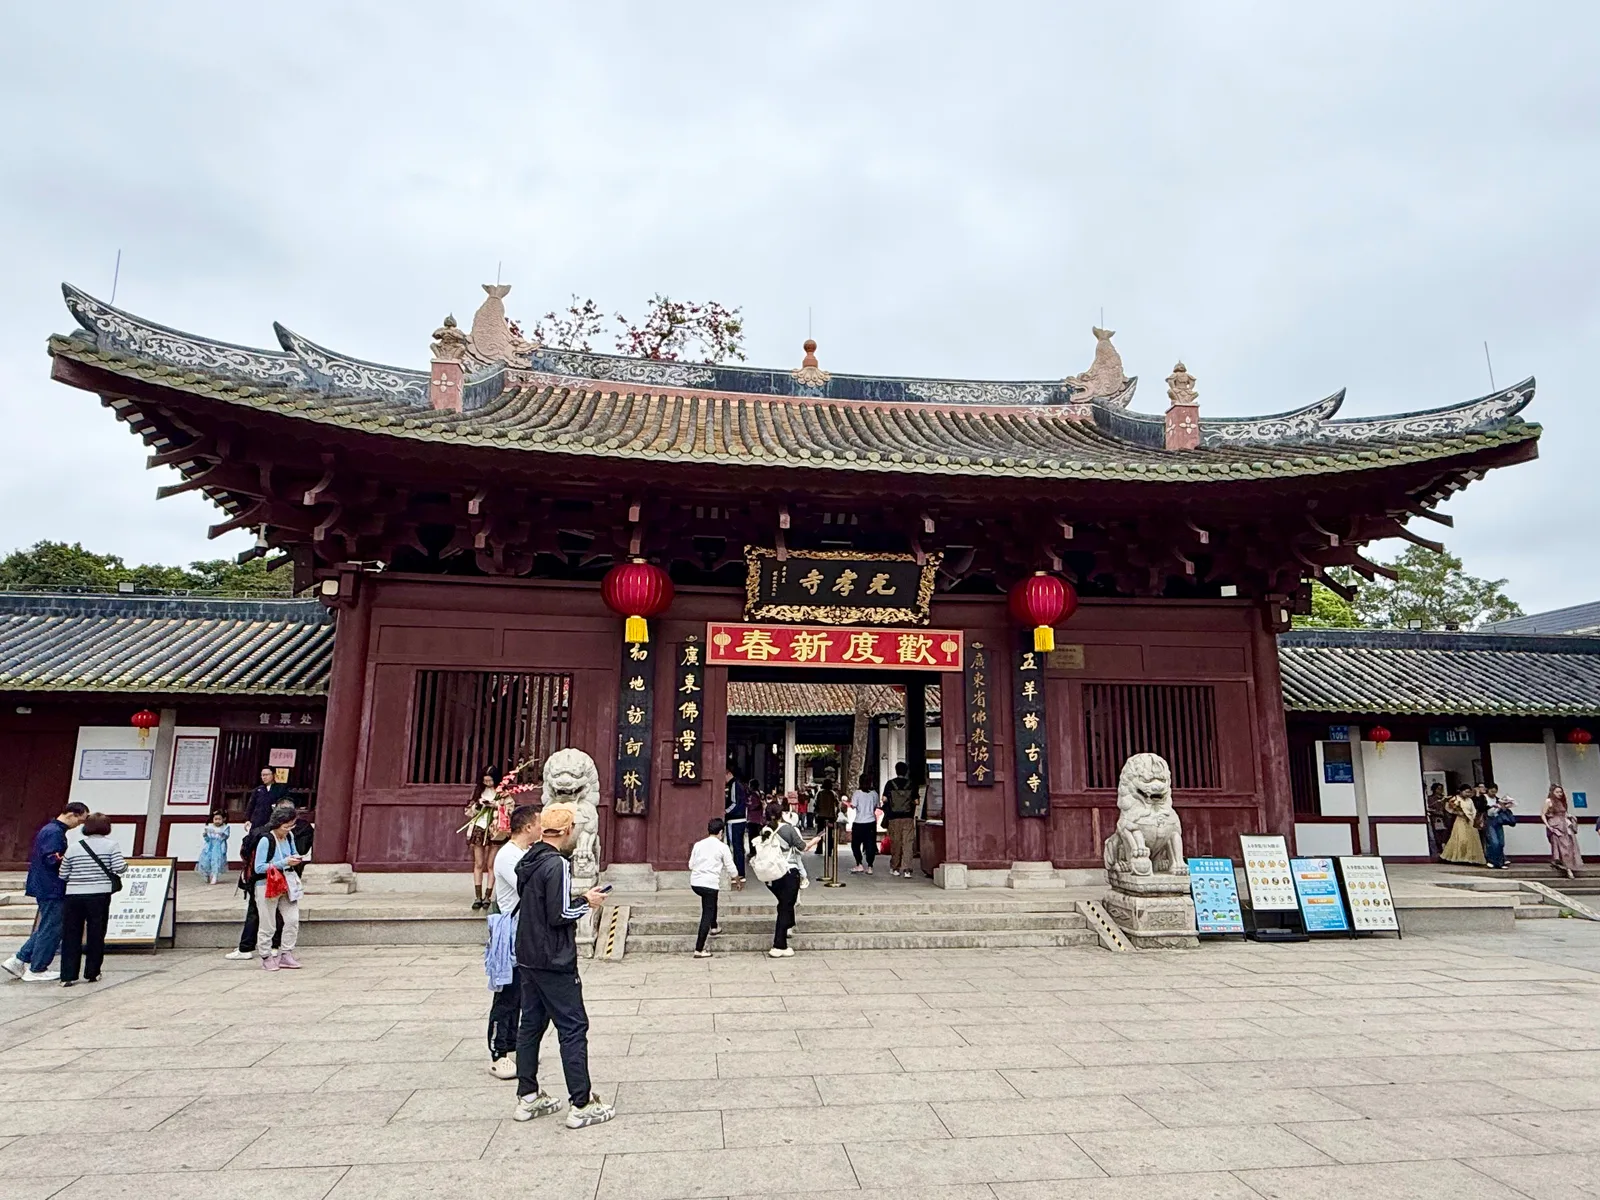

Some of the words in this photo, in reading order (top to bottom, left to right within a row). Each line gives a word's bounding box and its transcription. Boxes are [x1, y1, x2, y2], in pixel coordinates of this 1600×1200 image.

[799, 568, 897, 597] 光孝寺
[735, 628, 937, 665] 歡度新春
[259, 712, 312, 725] 售票处
[678, 646, 701, 779] 廣東佛學院
[970, 652, 991, 782] 廣東省佛教協會
[1446, 729, 1469, 742] 出口
